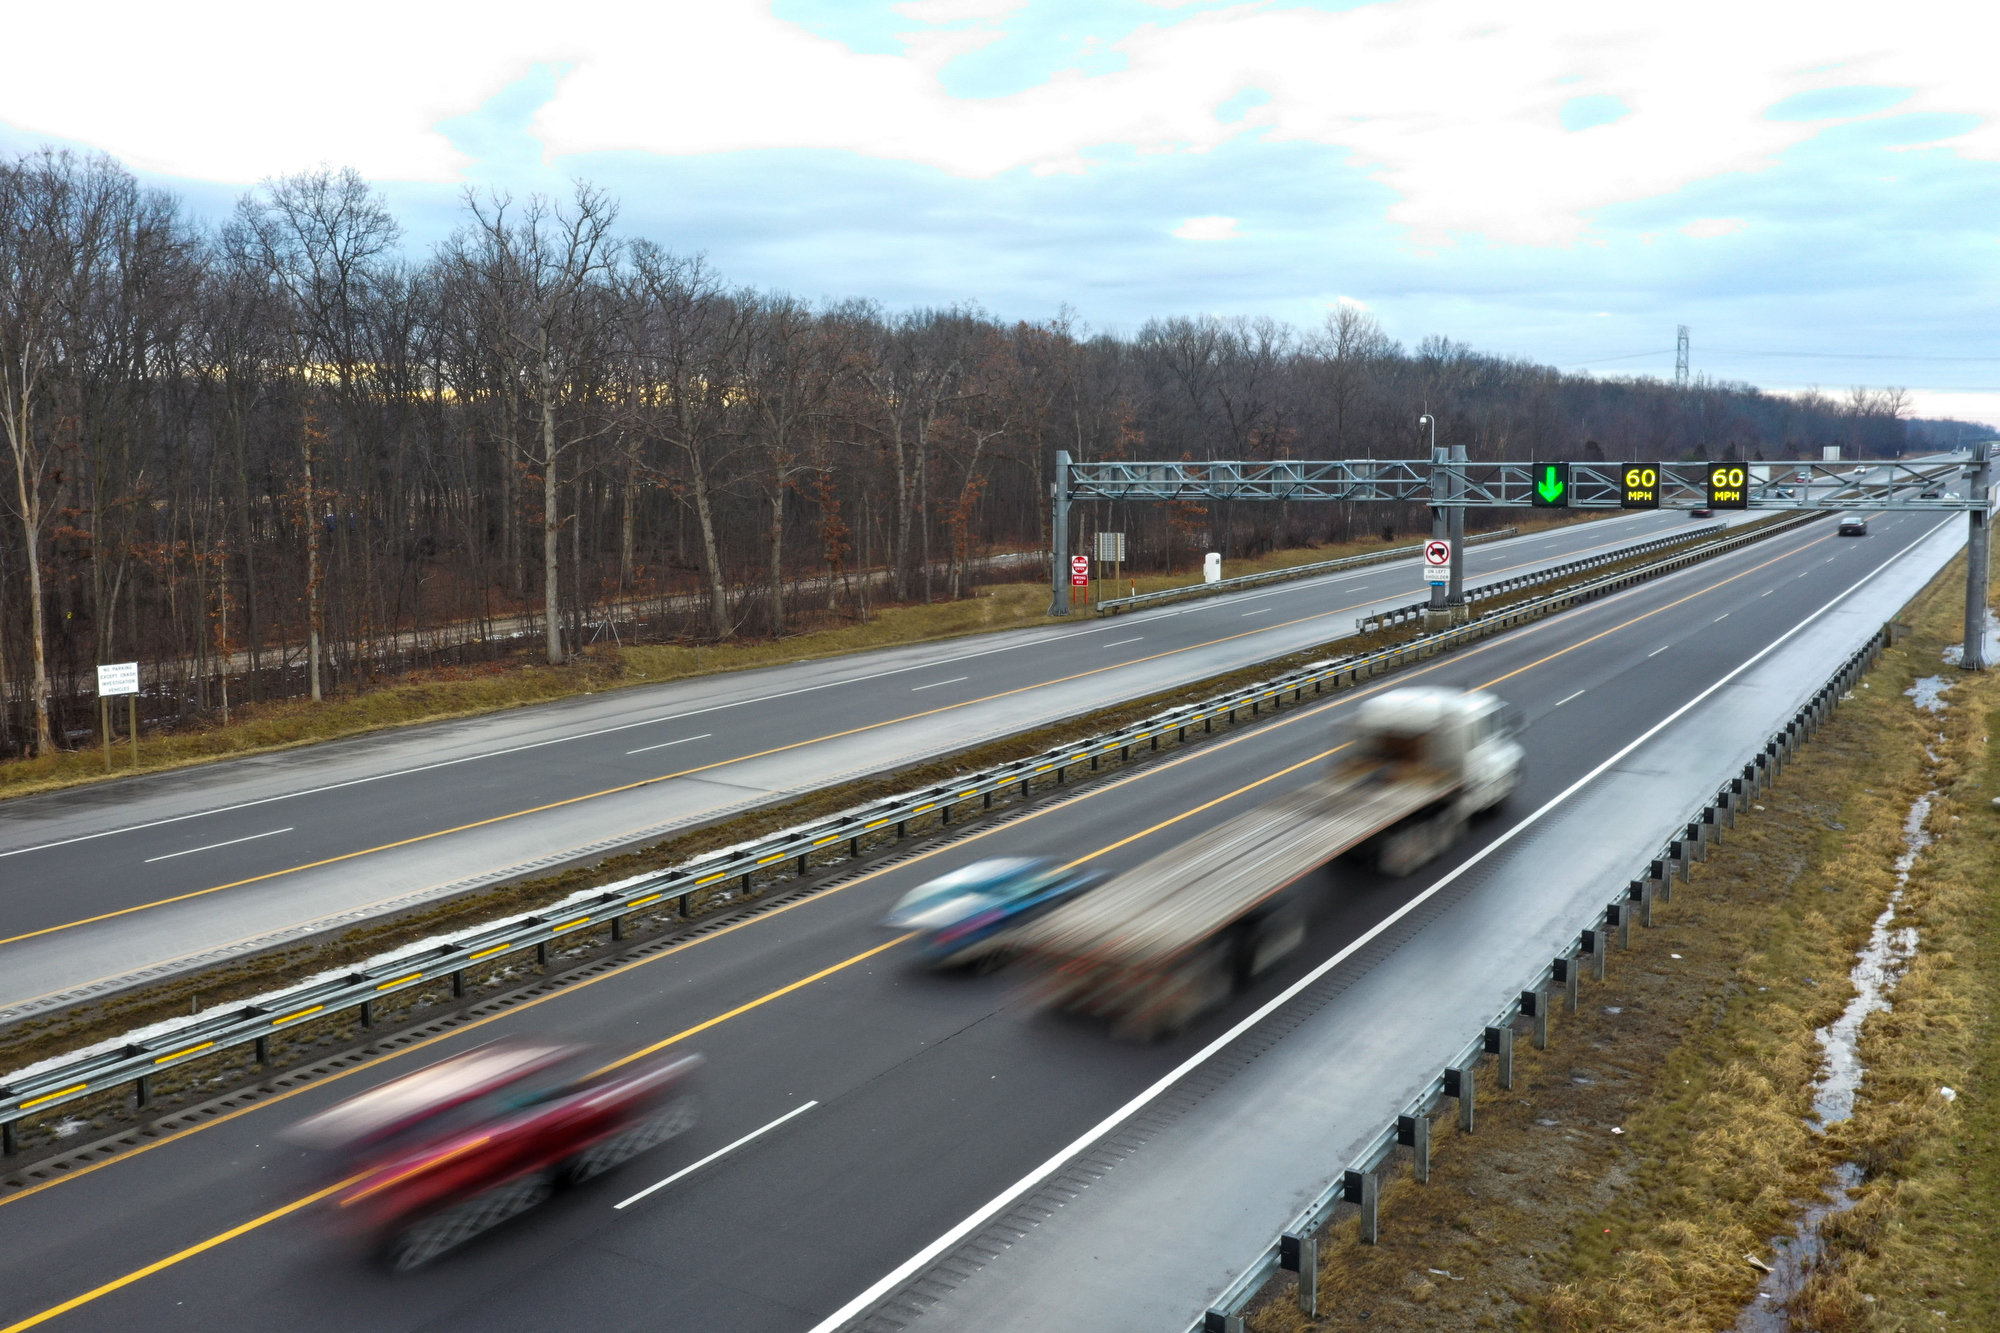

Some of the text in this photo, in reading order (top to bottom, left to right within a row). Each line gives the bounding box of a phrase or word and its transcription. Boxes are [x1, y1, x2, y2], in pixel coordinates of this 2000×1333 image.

[1626, 469, 1656, 487] 60
[1712, 468, 1744, 487] 60
[1628, 491, 1652, 501] MPH
[1714, 491, 1740, 501] MPH
